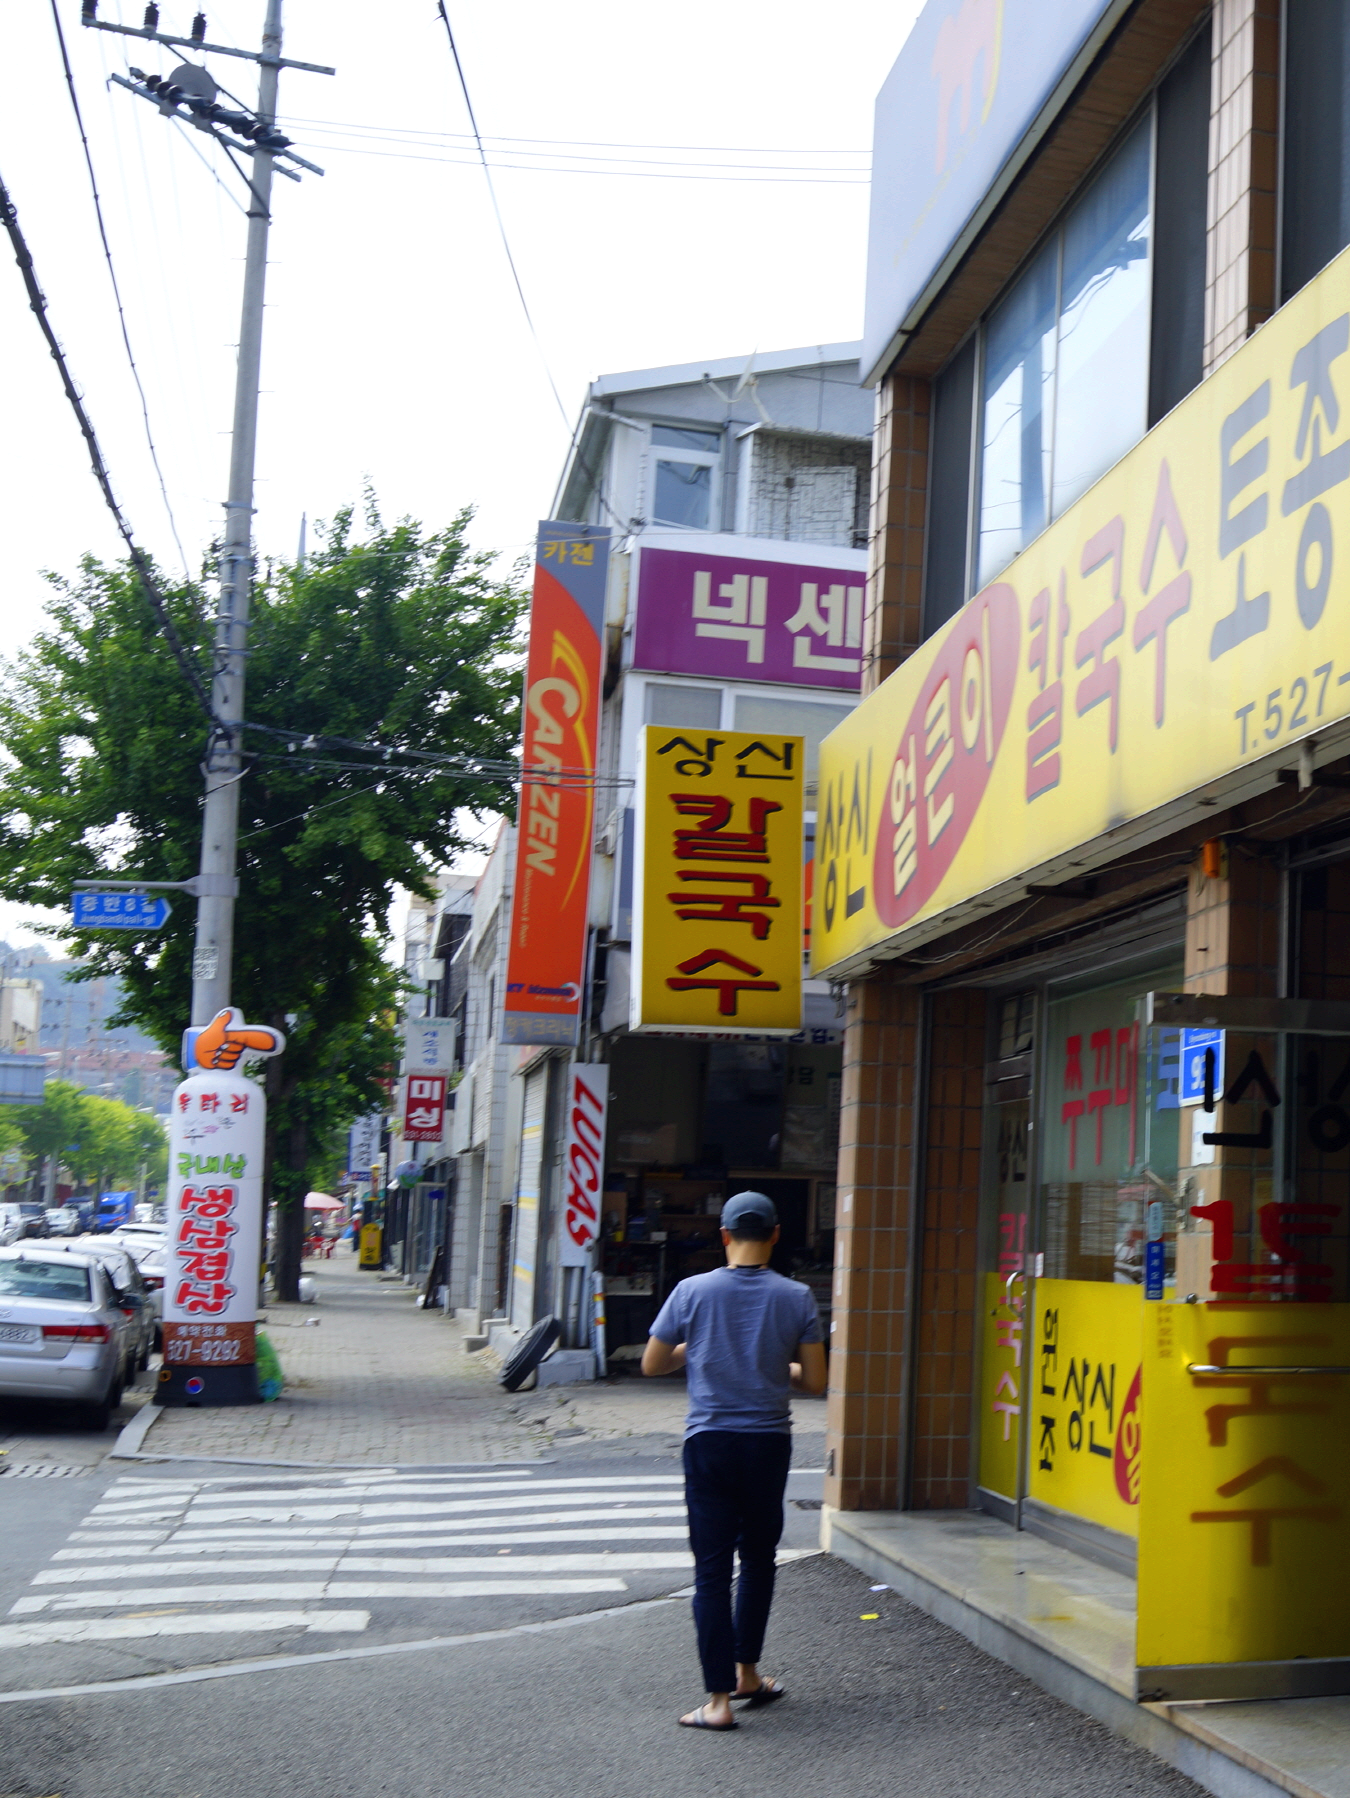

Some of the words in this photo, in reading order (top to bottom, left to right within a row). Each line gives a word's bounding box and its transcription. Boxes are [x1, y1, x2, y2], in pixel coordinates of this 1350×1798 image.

[543, 541, 595, 566] 카젠
[656, 736, 795, 780] 상신
[819, 746, 872, 932] 상신
[889, 602, 994, 898] 얼큰이
[1024, 456, 1193, 804] 칼국수
[525, 676, 579, 877] CARZEN
[665, 793, 783, 1016] 칼국수
[177, 1152, 247, 1179] 국내산
[567, 1073, 603, 1247] LUCAS
[1062, 1020, 1139, 1170] 쭈꾸미
[175, 1185, 237, 1315] 생삼겹살
[1040, 1308, 1059, 1472] 원조
[1063, 1356, 1115, 1460] 상신
